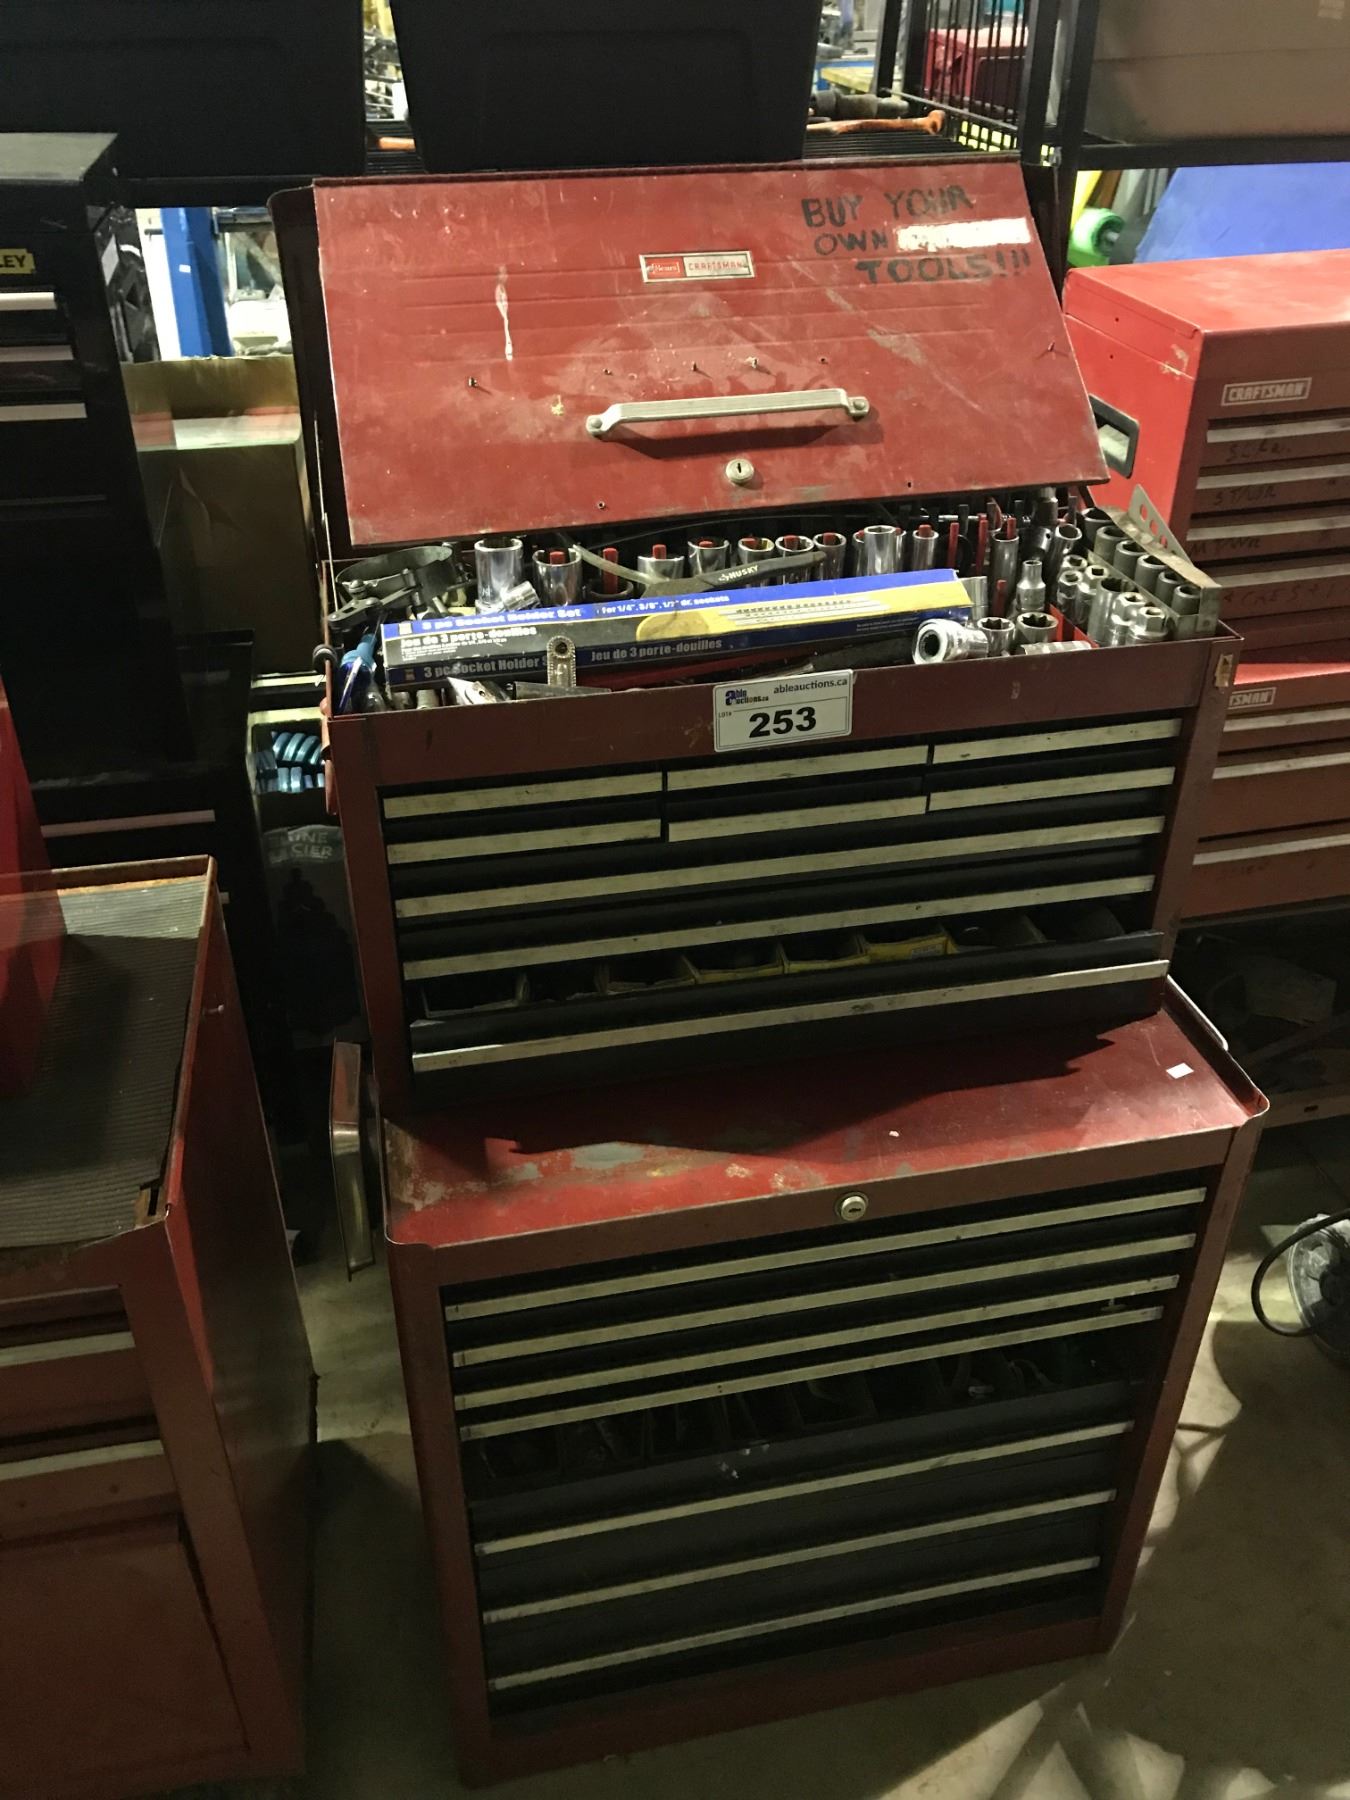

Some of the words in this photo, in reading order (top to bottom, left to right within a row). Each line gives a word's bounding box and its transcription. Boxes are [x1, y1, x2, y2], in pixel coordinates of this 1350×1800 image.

[801, 194, 863, 227] BUY
[884, 185, 975, 219] YOUR
[814, 230, 889, 255] OWN
[688, 261, 742, 271] CRAFTSMAN
[1228, 382, 1305, 401] CRAFTSMAN
[728, 565, 759, 579] HUSKY
[557, 608, 582, 618] Set
[612, 648, 627, 659] de
[629, 646, 637, 657] 3
[638, 639, 723, 658] porte-douilles
[423, 667, 433, 678] 3
[449, 660, 498, 675] Socket
[498, 656, 542, 671] Holder
[773, 678, 848, 694] ableauctions.ca
[749, 706, 817, 738] 253
